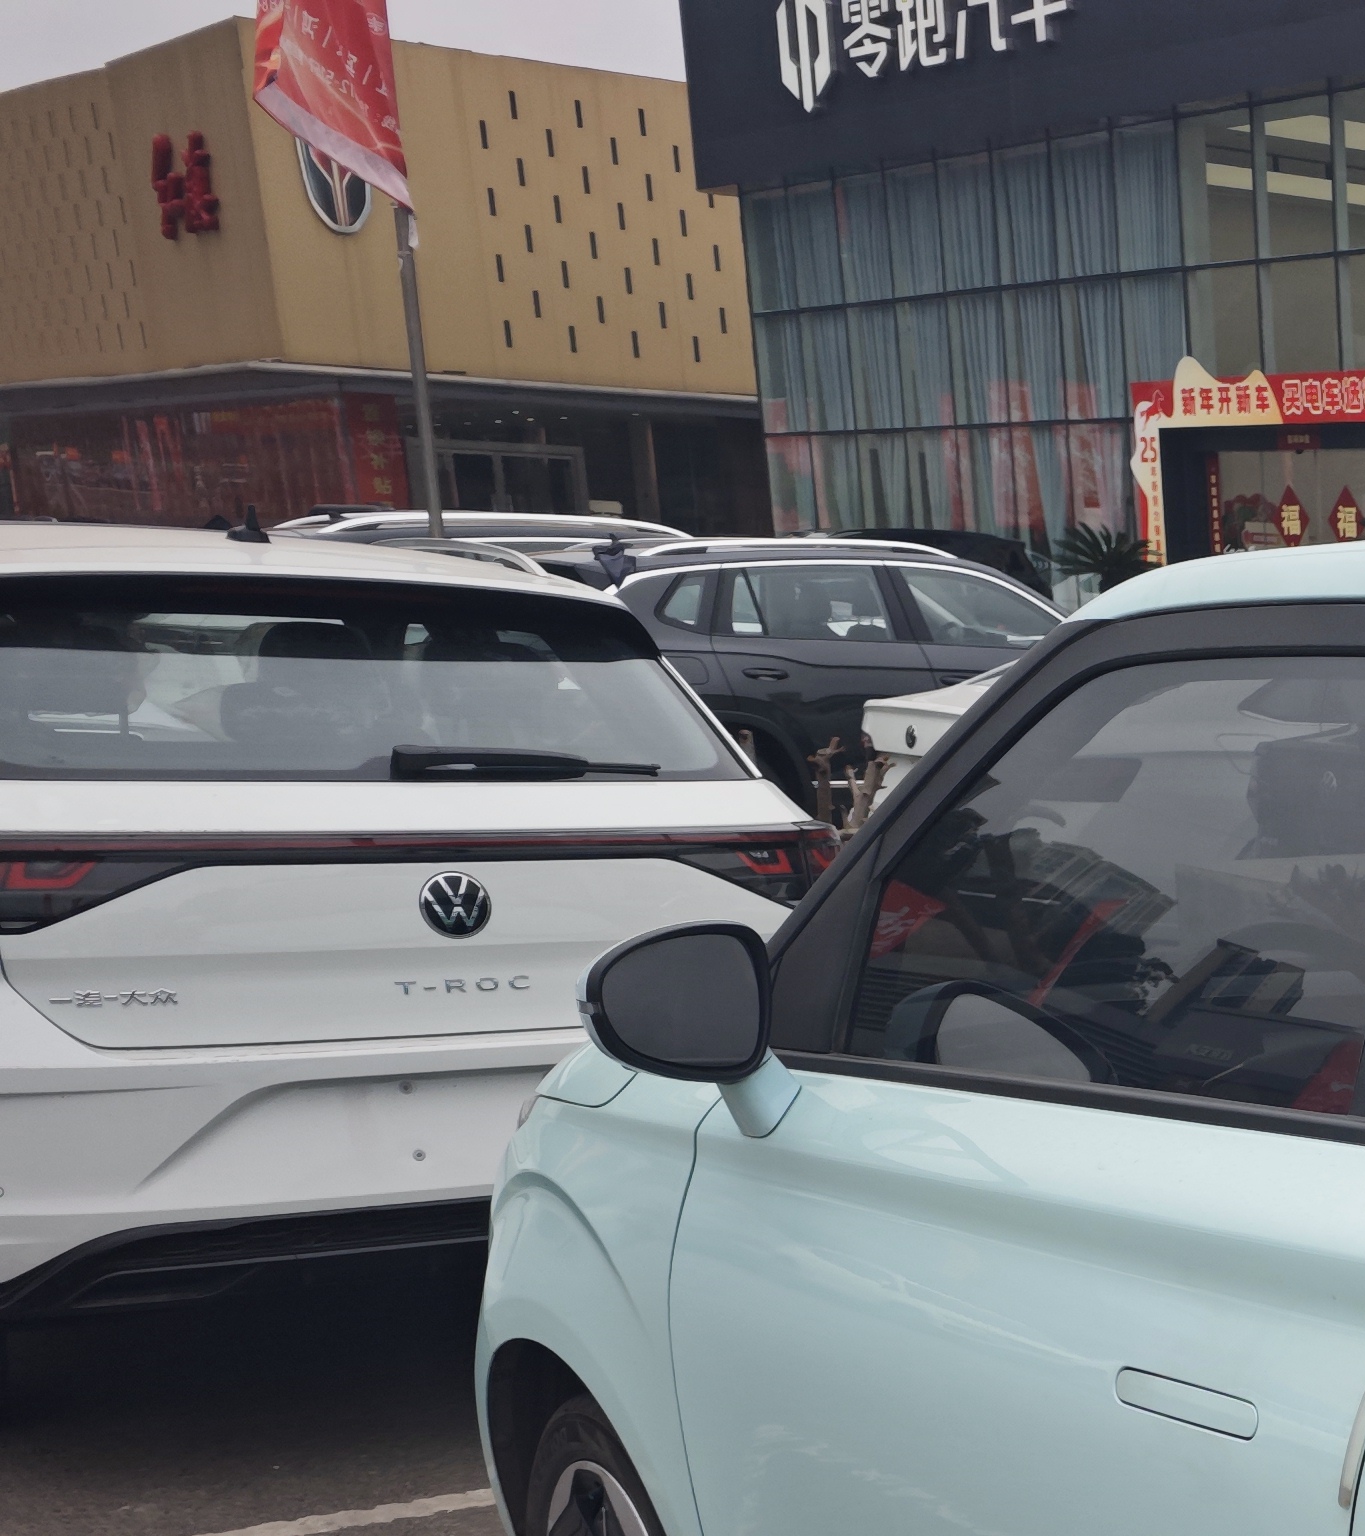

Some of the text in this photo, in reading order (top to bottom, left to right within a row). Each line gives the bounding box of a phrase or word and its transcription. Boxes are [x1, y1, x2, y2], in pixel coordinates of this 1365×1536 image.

[1181, 383, 1271, 417] 新年开新车
[1281, 503, 1302, 537] 福
[1336, 506, 1358, 539] 福
[394, 975, 531, 996] T-ROC
